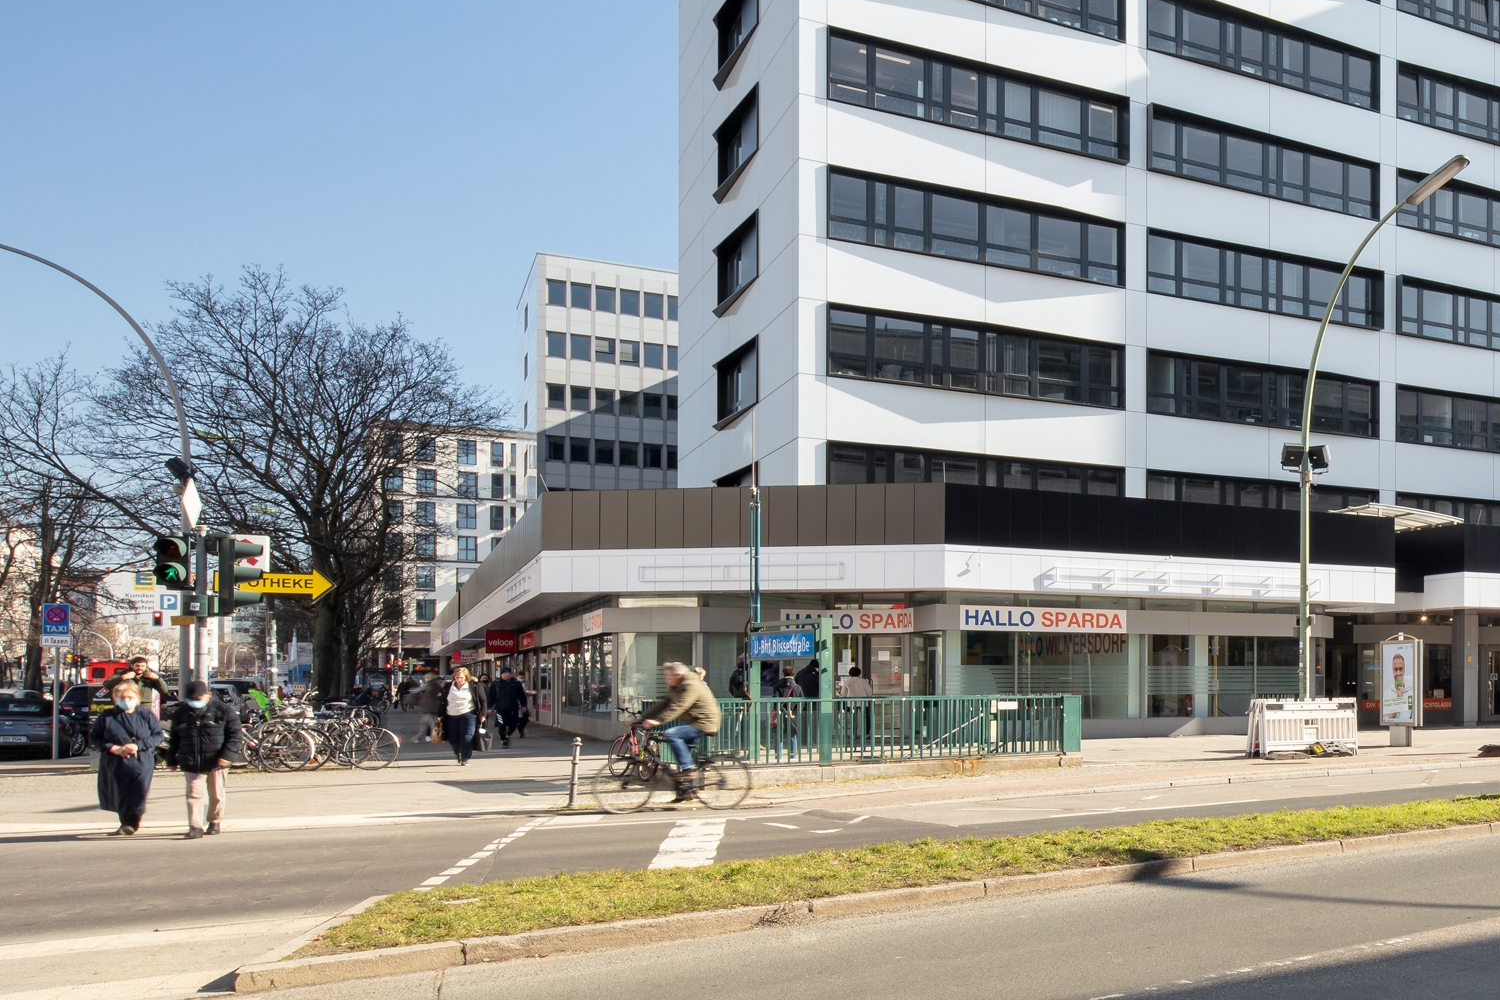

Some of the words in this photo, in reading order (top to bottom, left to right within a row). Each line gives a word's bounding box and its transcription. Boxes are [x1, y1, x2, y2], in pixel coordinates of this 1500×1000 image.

[247, 577, 314, 589] OTHEKE
[163, 595, 176, 609] P
[785, 613, 854, 630] HALO
[859, 612, 913, 630] SPARDA
[964, 609, 1035, 628] HALLO
[1041, 611, 1123, 629] SPARDA
[45, 625, 68, 633] TAXI
[488, 638, 514, 646] veloce
[754, 638, 772, 654] U-Bhf
[772, 636, 810, 653] Blissestraße
[1045, 633, 1127, 657] WILMERSDORF
